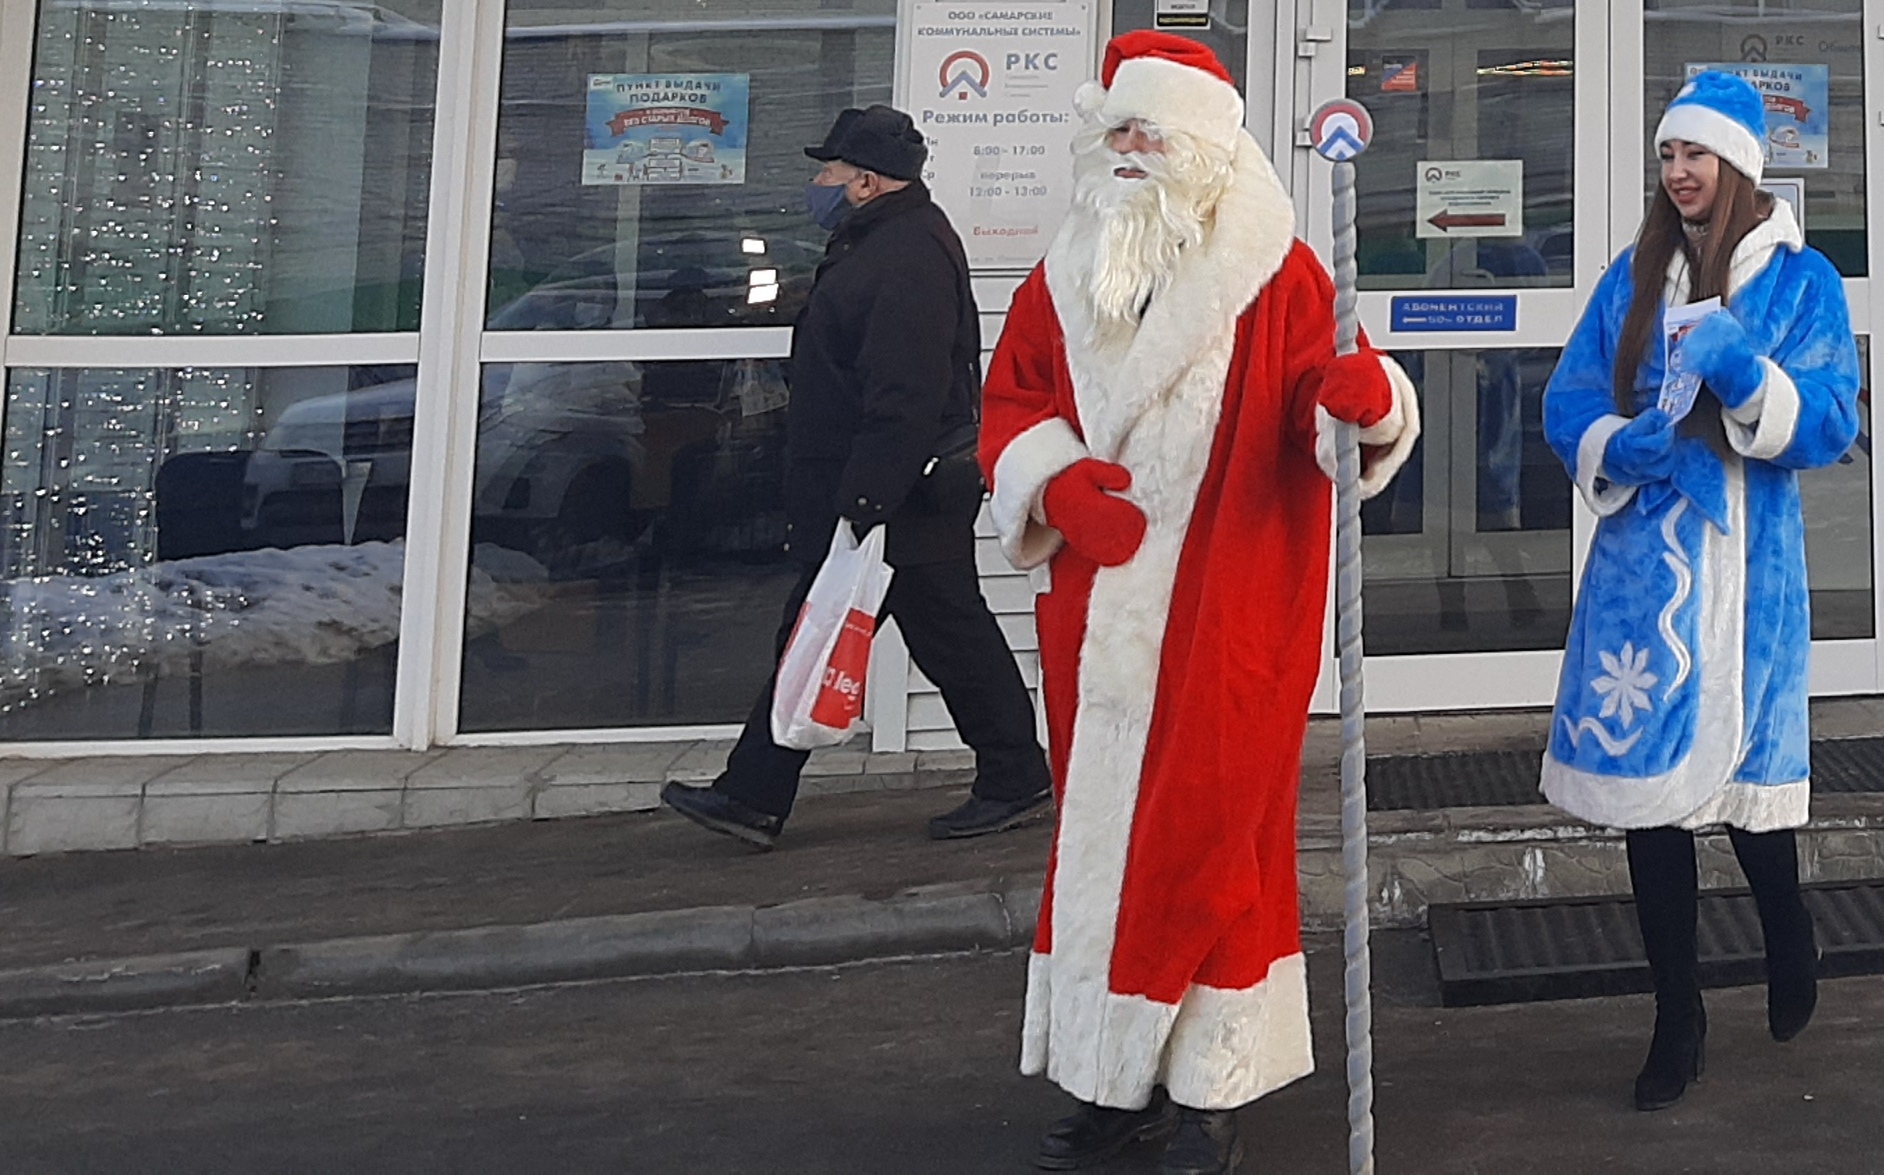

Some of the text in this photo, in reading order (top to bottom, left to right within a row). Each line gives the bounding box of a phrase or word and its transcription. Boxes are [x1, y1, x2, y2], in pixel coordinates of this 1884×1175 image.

[948, 11, 976, 21] ООО
[918, 27, 1018, 37] КОММУНАЛЬНЫЕ
[1005, 53, 1059, 71] РКС
[1753, 69, 1803, 81] ВЫДАЧИ
[616, 80, 659, 93] ПУНКТ
[664, 80, 721, 92] ВЫДАЧИ
[1751, 80, 1790, 92] АРКОВ
[629, 92, 707, 104] ПОДАРКОВ
[922, 109, 1070, 127] Режим работы:
[1013, 145, 1045, 156] 17:00
[970, 186, 1002, 197] 12:00
[1015, 185, 1048, 197] 13:00
[1402, 302, 1504, 312] АБОНЕНТСКИЙ
[1456, 315, 1504, 324] ОТДЕЛ
